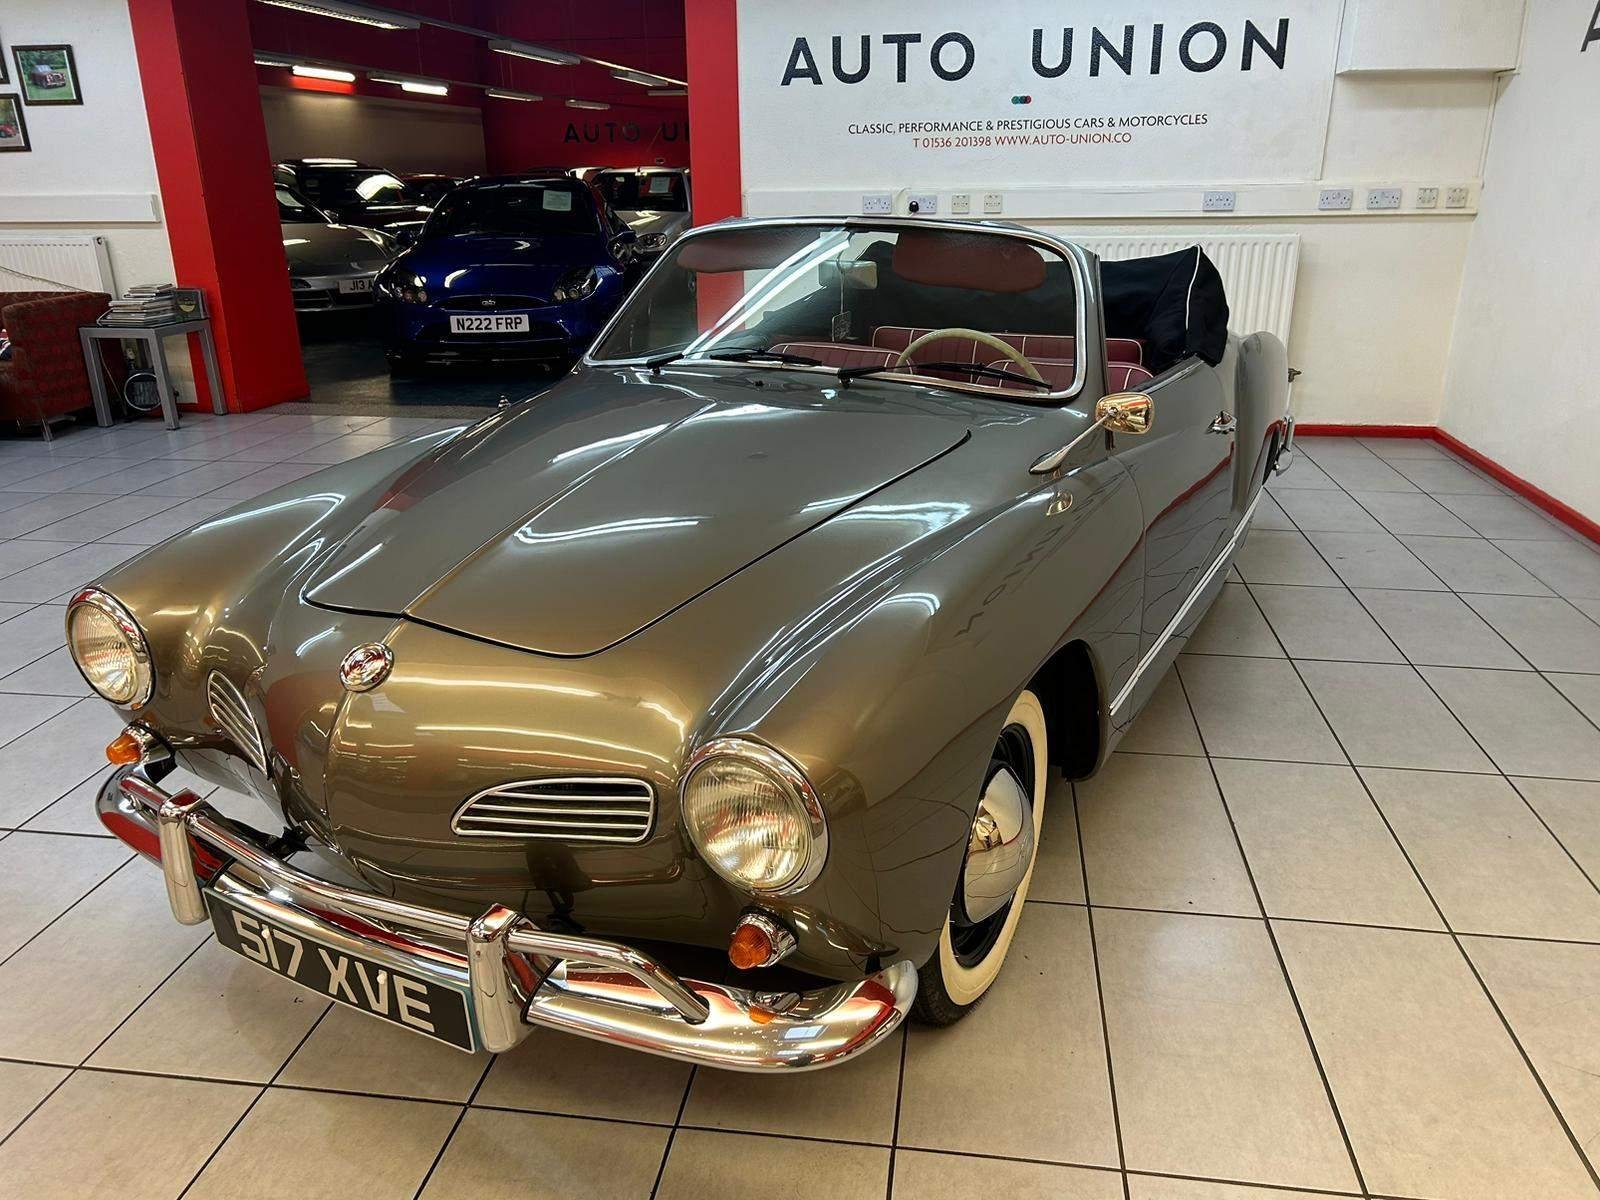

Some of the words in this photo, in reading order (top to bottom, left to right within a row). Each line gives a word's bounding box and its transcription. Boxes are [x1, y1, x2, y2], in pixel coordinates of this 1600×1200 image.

[781, 31, 975, 86] AUTO
[1031, 18, 1290, 78] UNION
[564, 121, 640, 143] AUTO
[848, 123, 896, 135] CLASSIC,
[899, 121, 983, 133] PERFORMANCE
[985, 120, 993, 131] &
[997, 118, 1071, 131] PRESTIGIOUS
[1073, 117, 1104, 129] CARS
[1107, 117, 1116, 128] &
[1119, 114, 1208, 127] MOTORCYCLES
[913, 138, 920, 148] T
[922, 137, 952, 148] 01536
[955, 136, 991, 147] 201398
[994, 133, 1132, 146] WWW.AUTO-UNION.CO
[456, 317, 492, 331] N222
[495, 316, 523, 331] FRP
[231, 909, 304, 978] 517
[318, 948, 435, 1033] XVE
